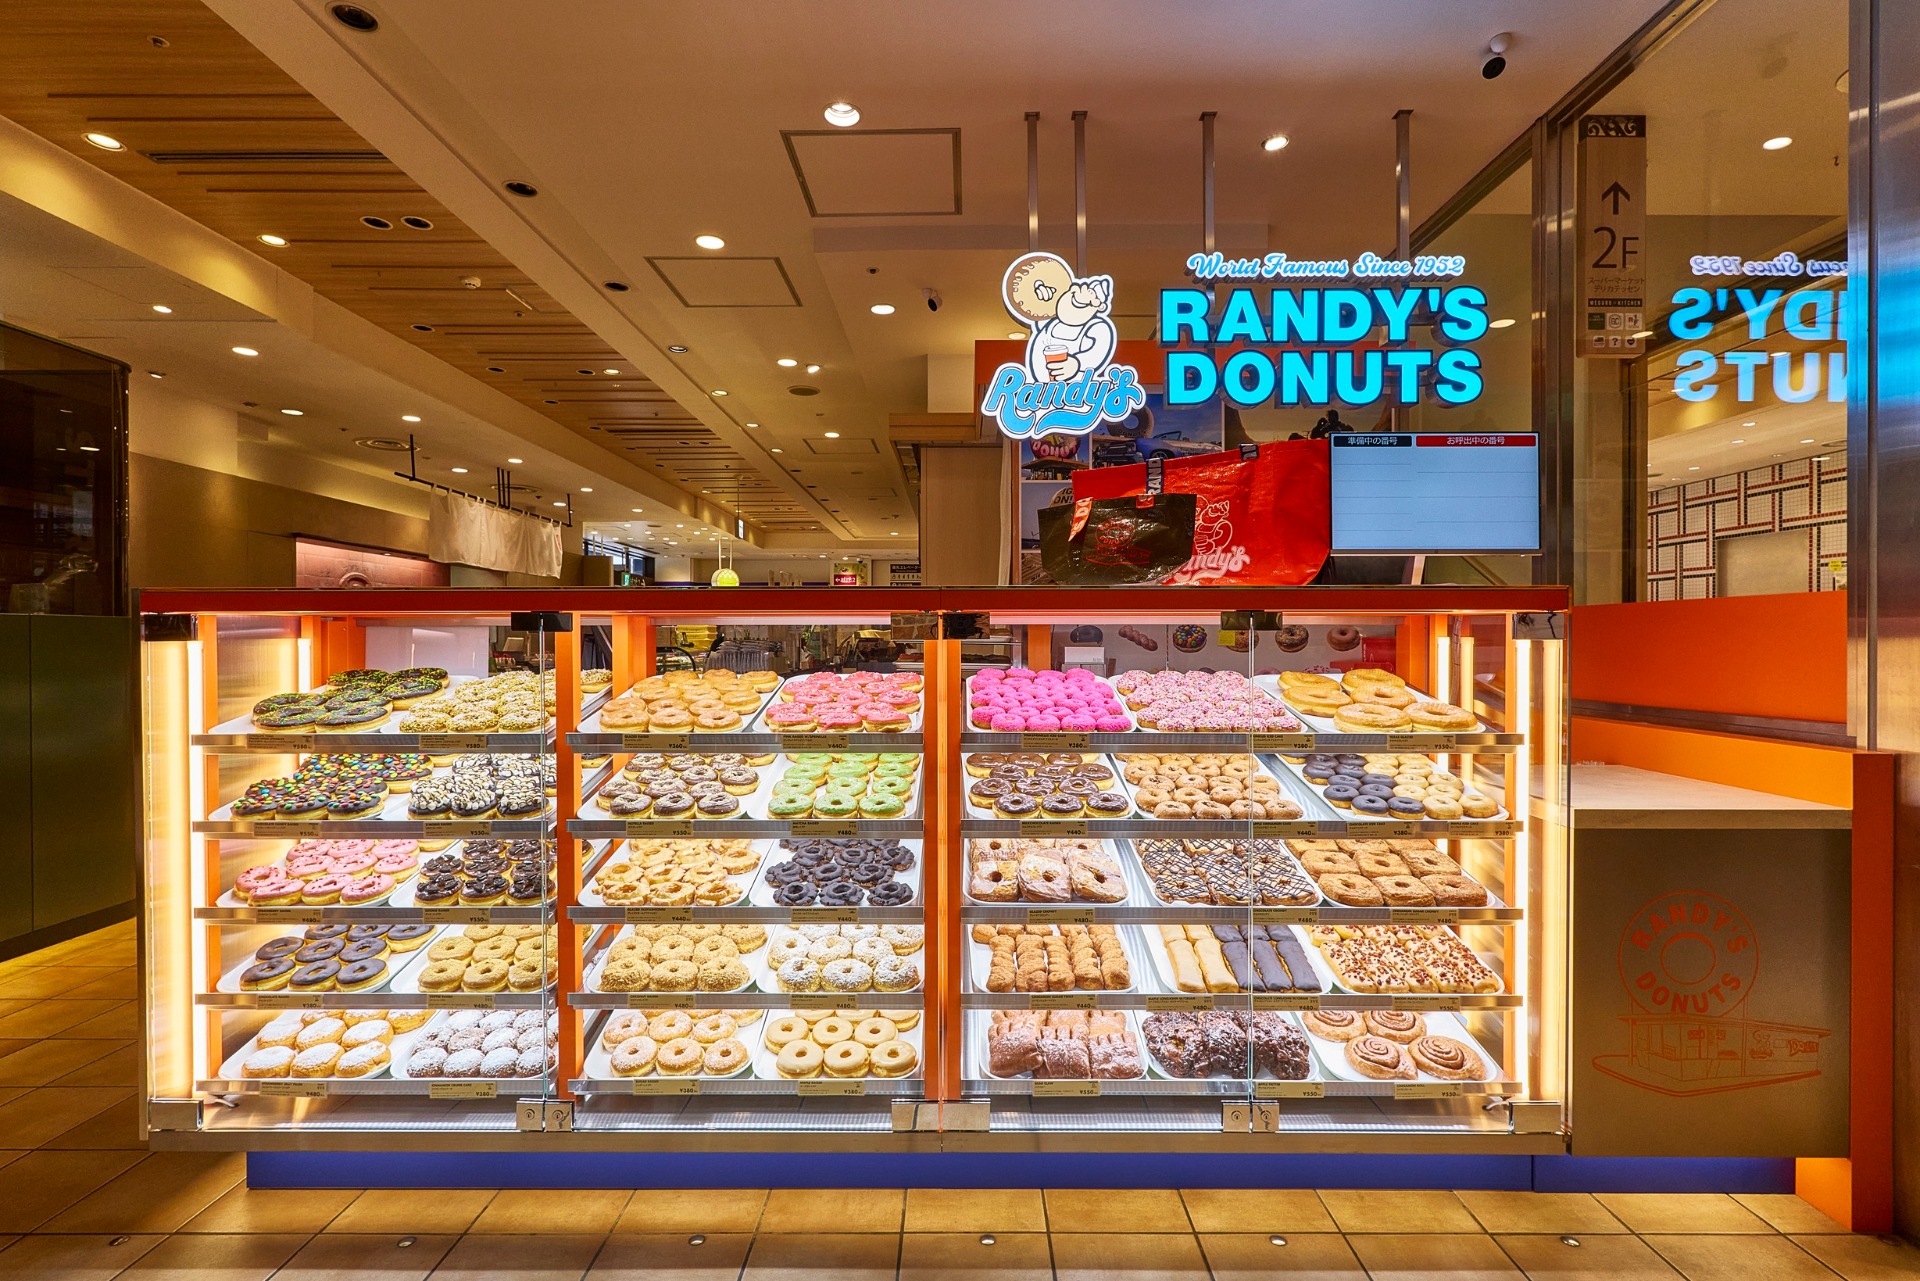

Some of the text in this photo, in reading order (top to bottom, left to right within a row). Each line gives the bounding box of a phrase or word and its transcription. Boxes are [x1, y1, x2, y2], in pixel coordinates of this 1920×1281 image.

[1187, 251, 1466, 278] World Famous Since 1952
[1592, 226, 1640, 269] 2F
[1161, 285, 1490, 343] RANDY'S
[1166, 348, 1485, 406] DONUTS
[985, 366, 1143, 435] Randy's
[1348, 436, 1398, 445] 準備中の番号
[1447, 436, 1506, 445] お呼出中の番号
[1632, 902, 1750, 955] RANDY'S
[1635, 971, 1742, 1014] DONUTS
